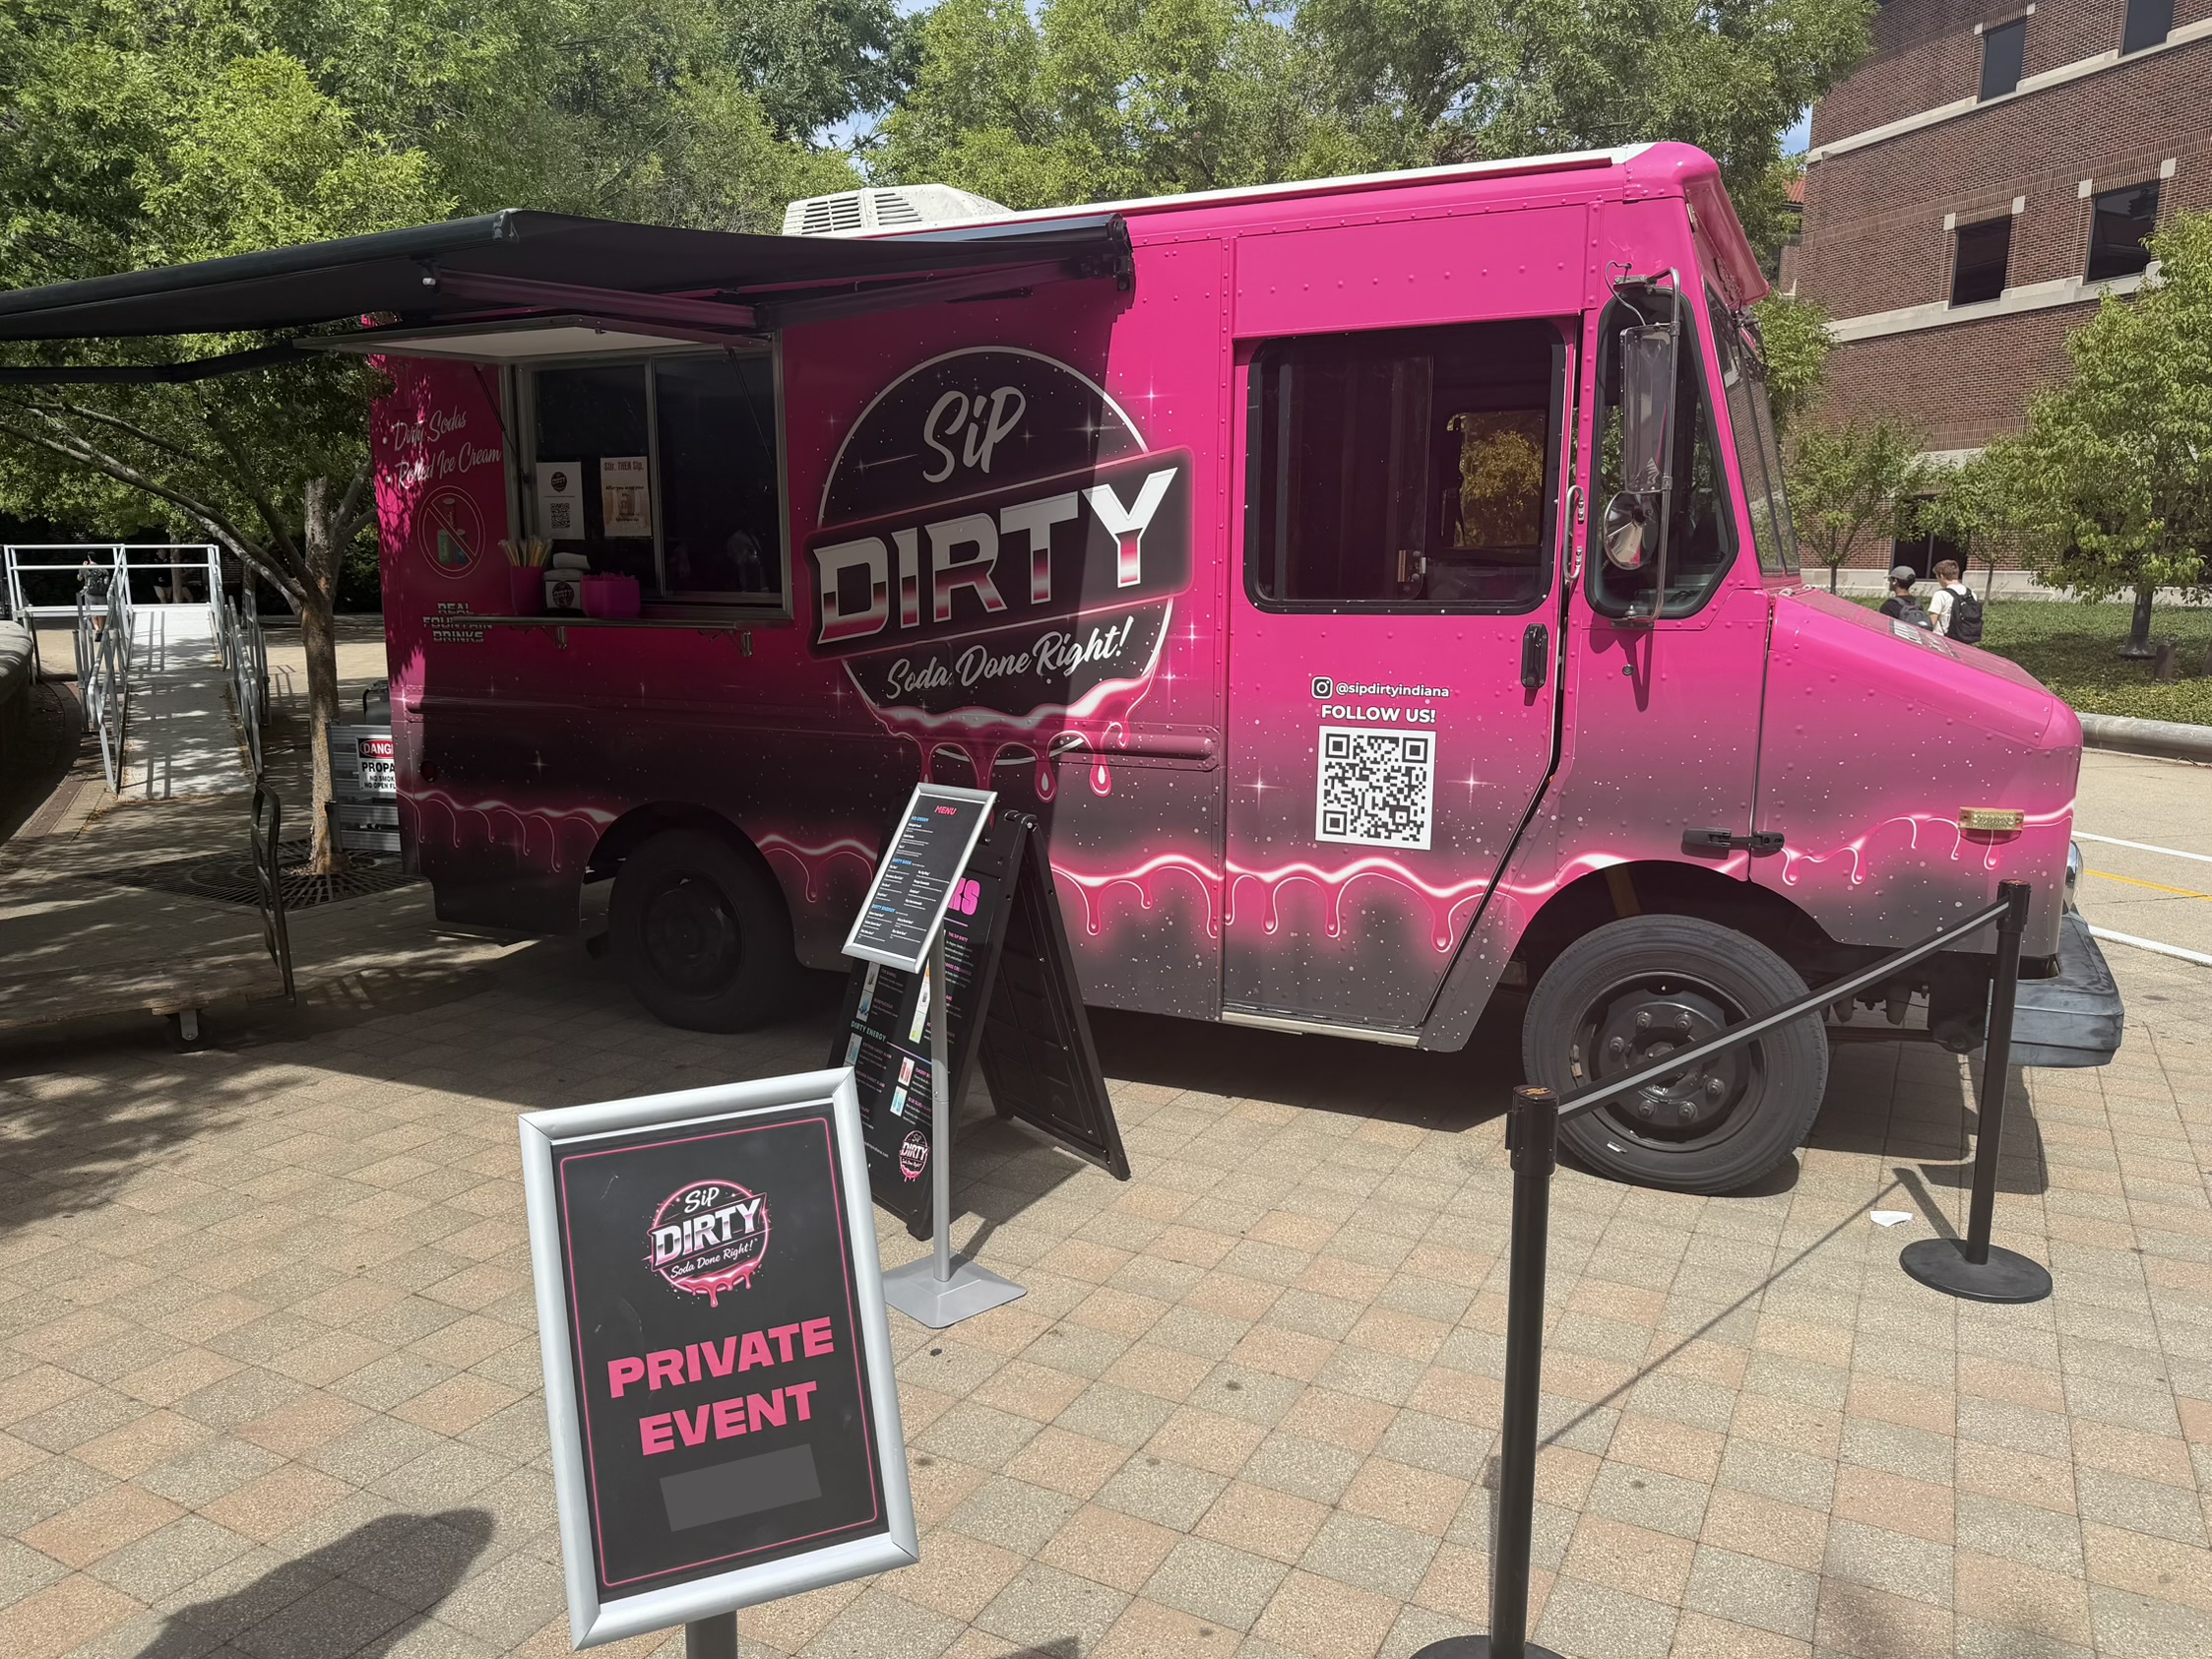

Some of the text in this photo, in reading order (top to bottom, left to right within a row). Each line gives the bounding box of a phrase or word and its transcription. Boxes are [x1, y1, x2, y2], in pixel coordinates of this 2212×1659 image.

[393, 405, 467, 451] Dirty Sodas
[395, 441, 502, 489] Rolled Ice Cream
[812, 467, 1178, 645] DIRTY
[437, 603, 474, 615] REAL
[433, 630, 484, 643] DRINKS
[886, 615, 1134, 700] Soda Done Right!
[1336, 681, 1450, 698] @sipdirtyindiana
[1321, 705, 1436, 723] FOLLOW US!
[934, 805, 958, 816] MENU
[851, 1020, 886, 1042] DIRTY ENERGY
[901, 1141, 928, 1161] DIRTY
[652, 1197, 762, 1266] DIRTY
[670, 1240, 754, 1279] Soda Done Right!
[606, 1315, 835, 1399] PRIVATE
[638, 1380, 818, 1457] EVENT
